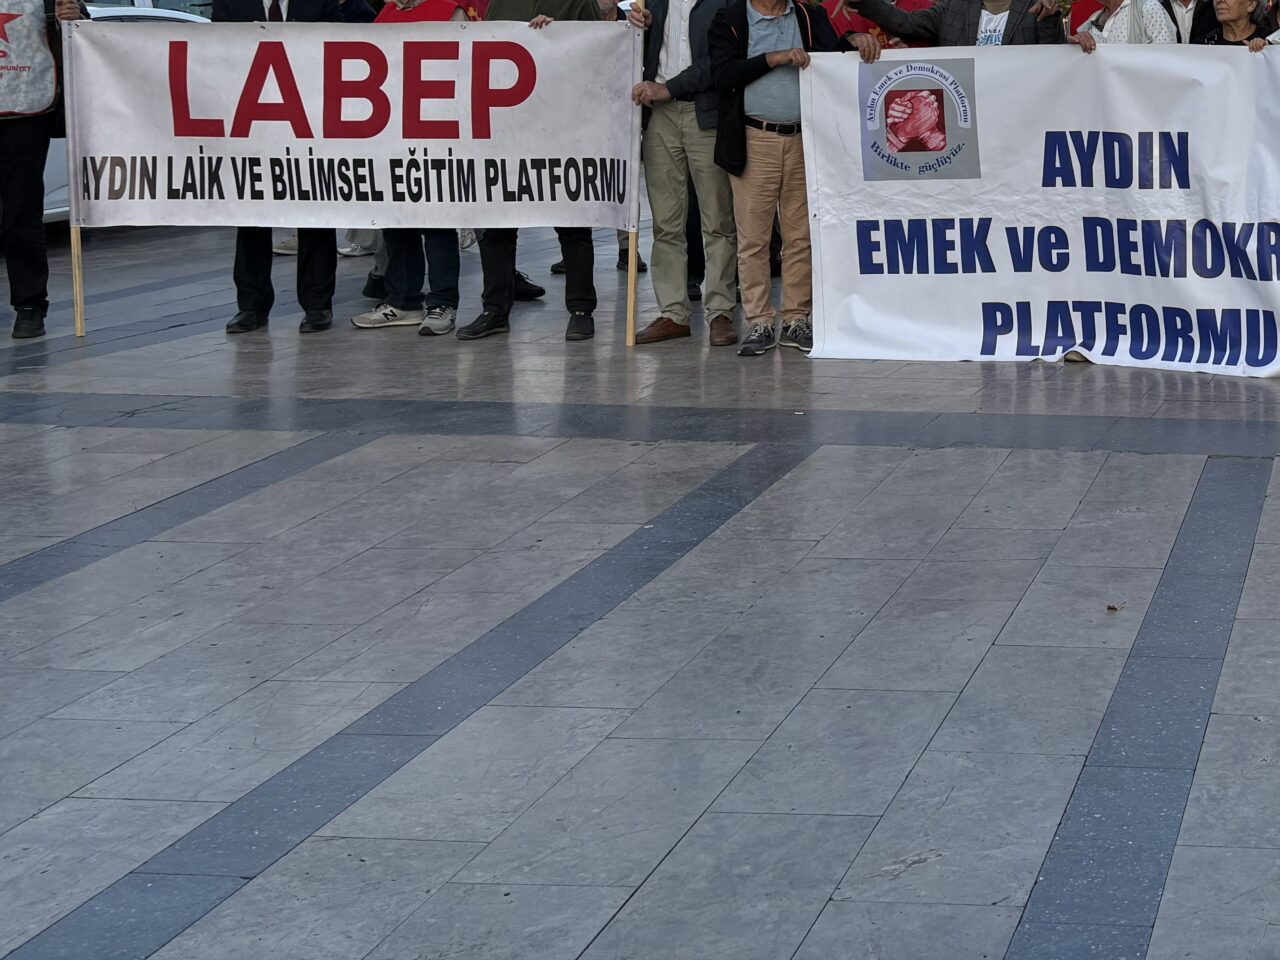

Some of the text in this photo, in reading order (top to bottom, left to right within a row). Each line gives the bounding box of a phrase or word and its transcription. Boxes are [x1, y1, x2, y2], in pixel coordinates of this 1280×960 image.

[168, 40, 537, 139] LABEP
[872, 74, 893, 96] Emek
[894, 69, 904, 77] ve
[906, 64, 951, 82] Demokrasi
[949, 79, 969, 123] Platformu
[167, 145, 225, 200] LAİK
[231, 156, 265, 201] VE
[269, 146, 384, 202] BİLİMSEL
[389, 147, 477, 203] EĞİTİM
[484, 157, 627, 205] PLATFORMU
[871, 140, 965, 176] Birlikte güçlüyüz.
[1041, 130, 1191, 190] AYDIN
[856, 217, 996, 275] EMEK
[1005, 224, 1070, 273] ve
[980, 300, 1278, 368] PLATFORMU
